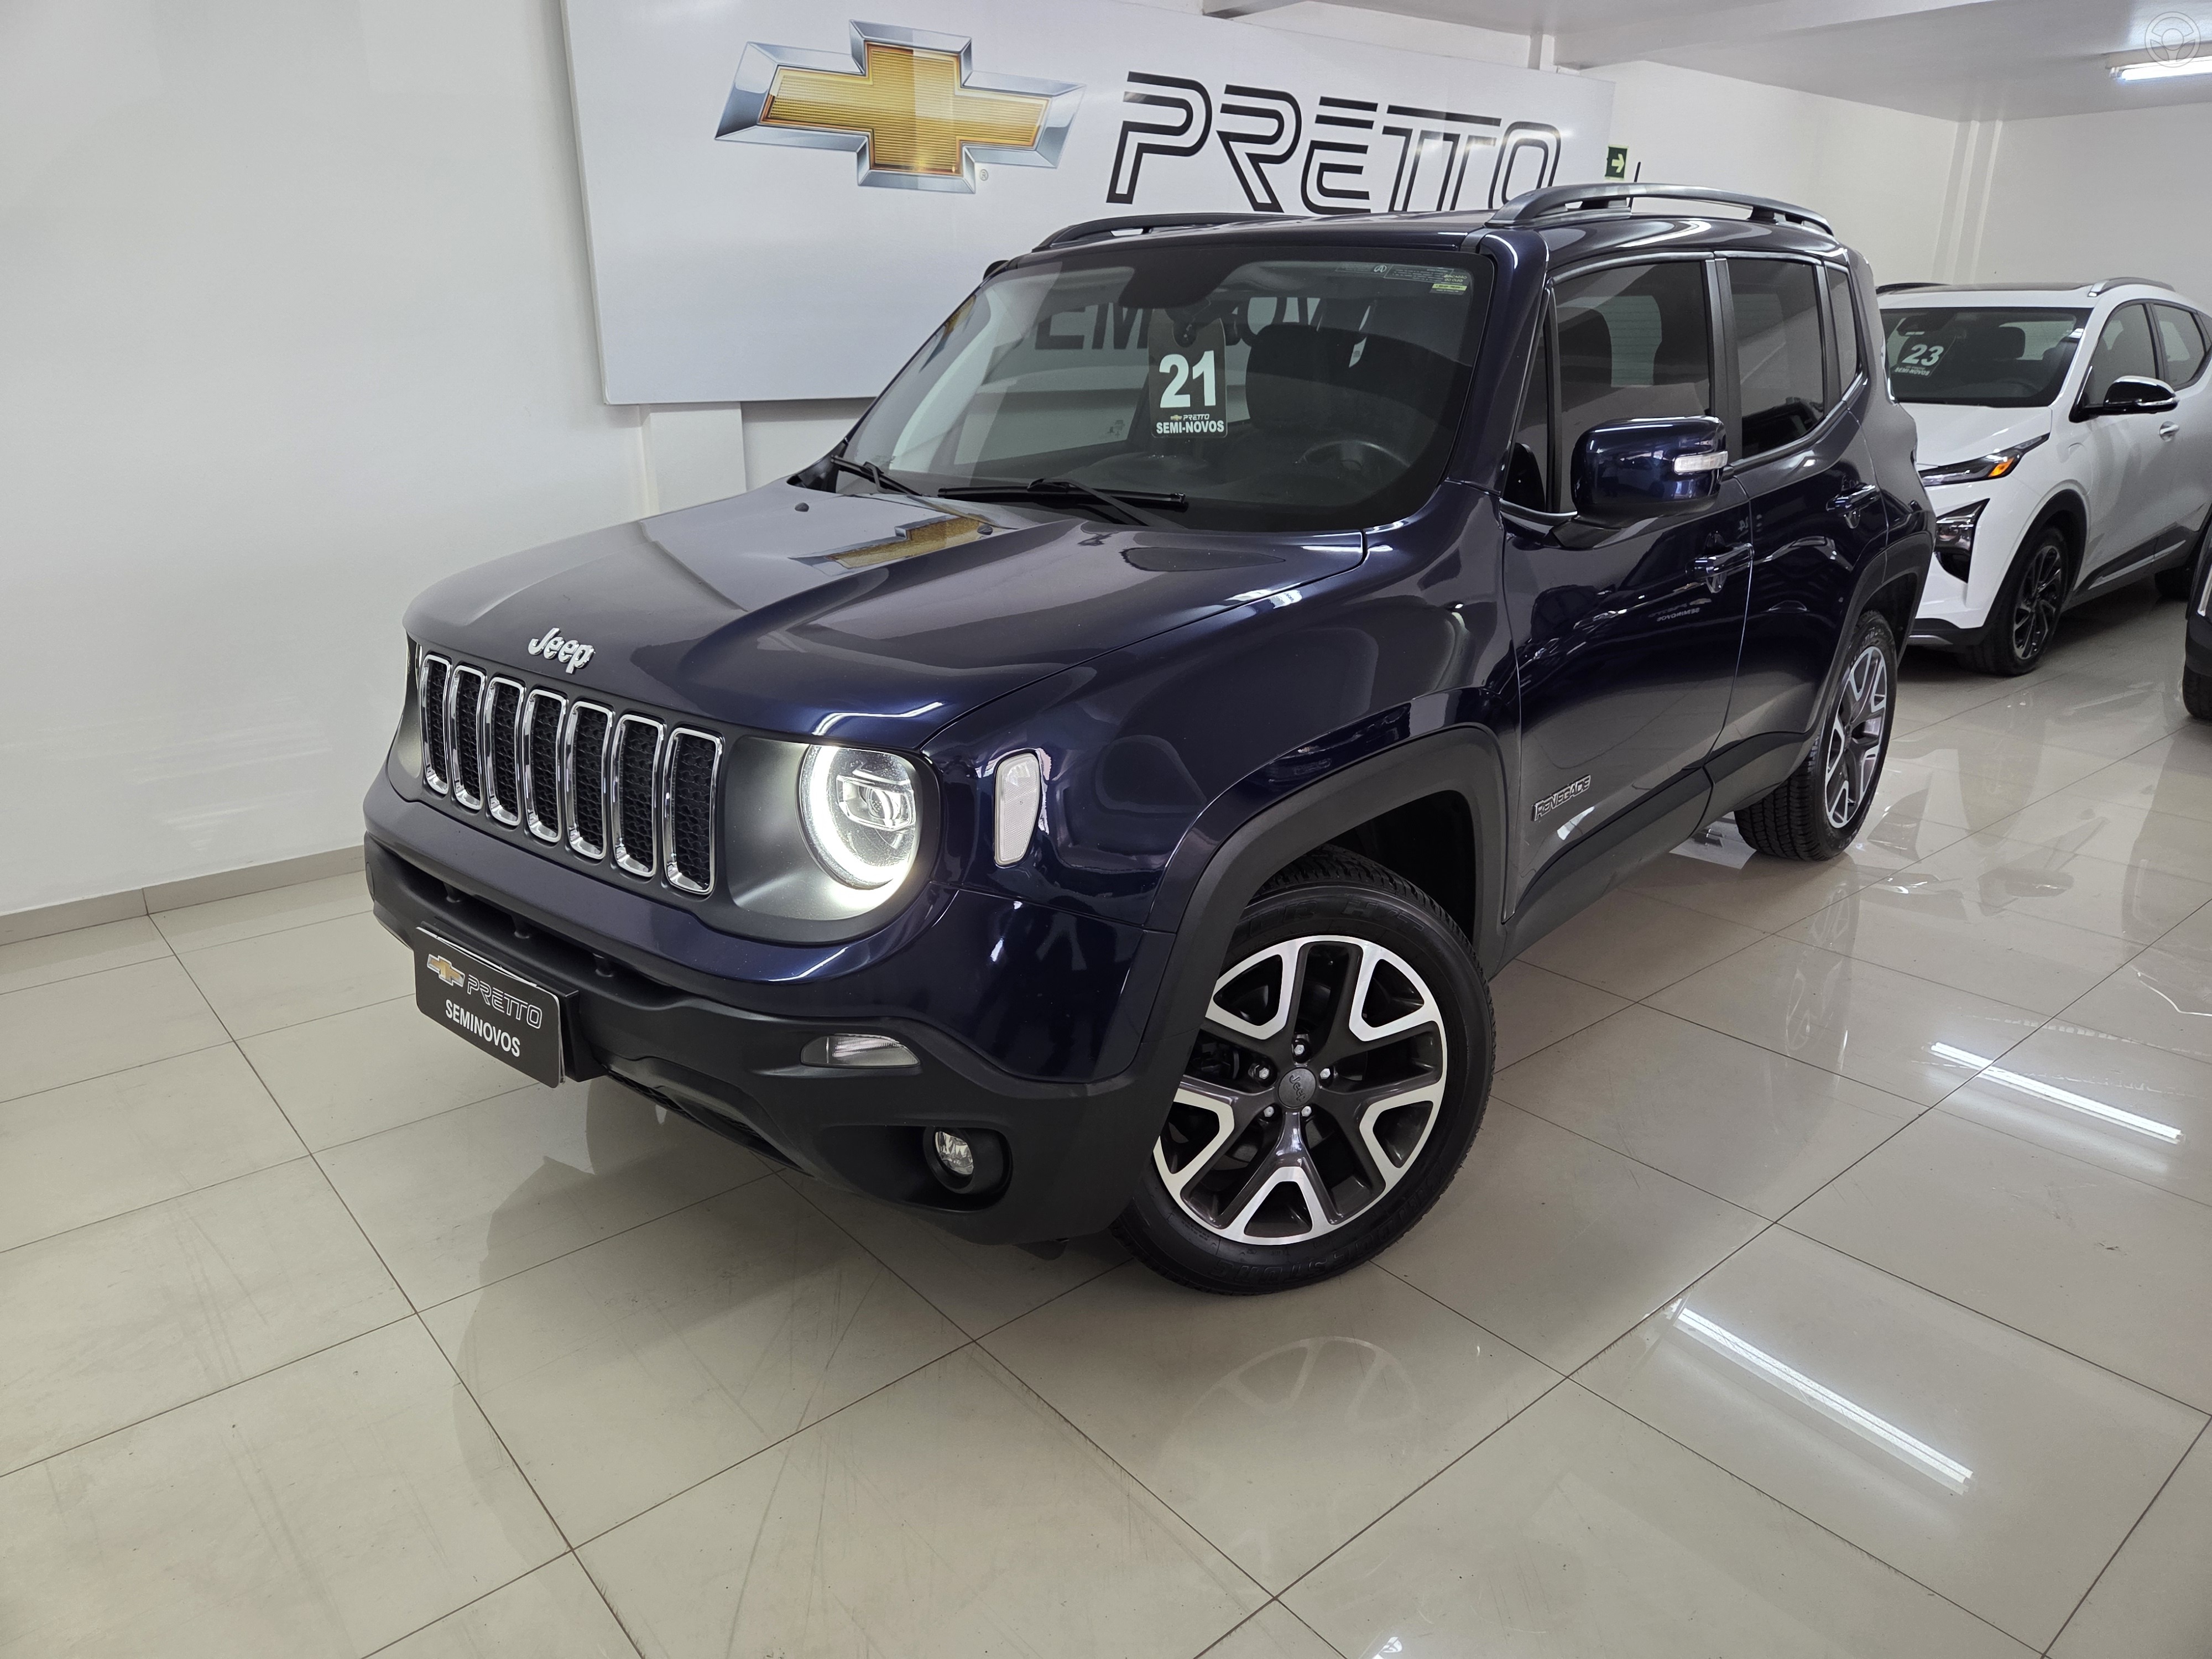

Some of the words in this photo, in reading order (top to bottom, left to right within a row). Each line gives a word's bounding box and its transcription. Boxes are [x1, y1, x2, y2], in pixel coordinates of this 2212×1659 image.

[1106, 71, 1561, 214] PRETTO
[1901, 344, 1944, 366] 23
[1159, 350, 1216, 408] 21
[1156, 420, 1224, 434] SEMI-NOVOS
[1183, 413, 1210, 421] PRETTO
[528, 627, 595, 674] Jeep
[467, 974, 542, 1029] PRETTO
[445, 999, 520, 1057] SEMINOVOS
[1289, 1074, 1306, 1102] Jeep
